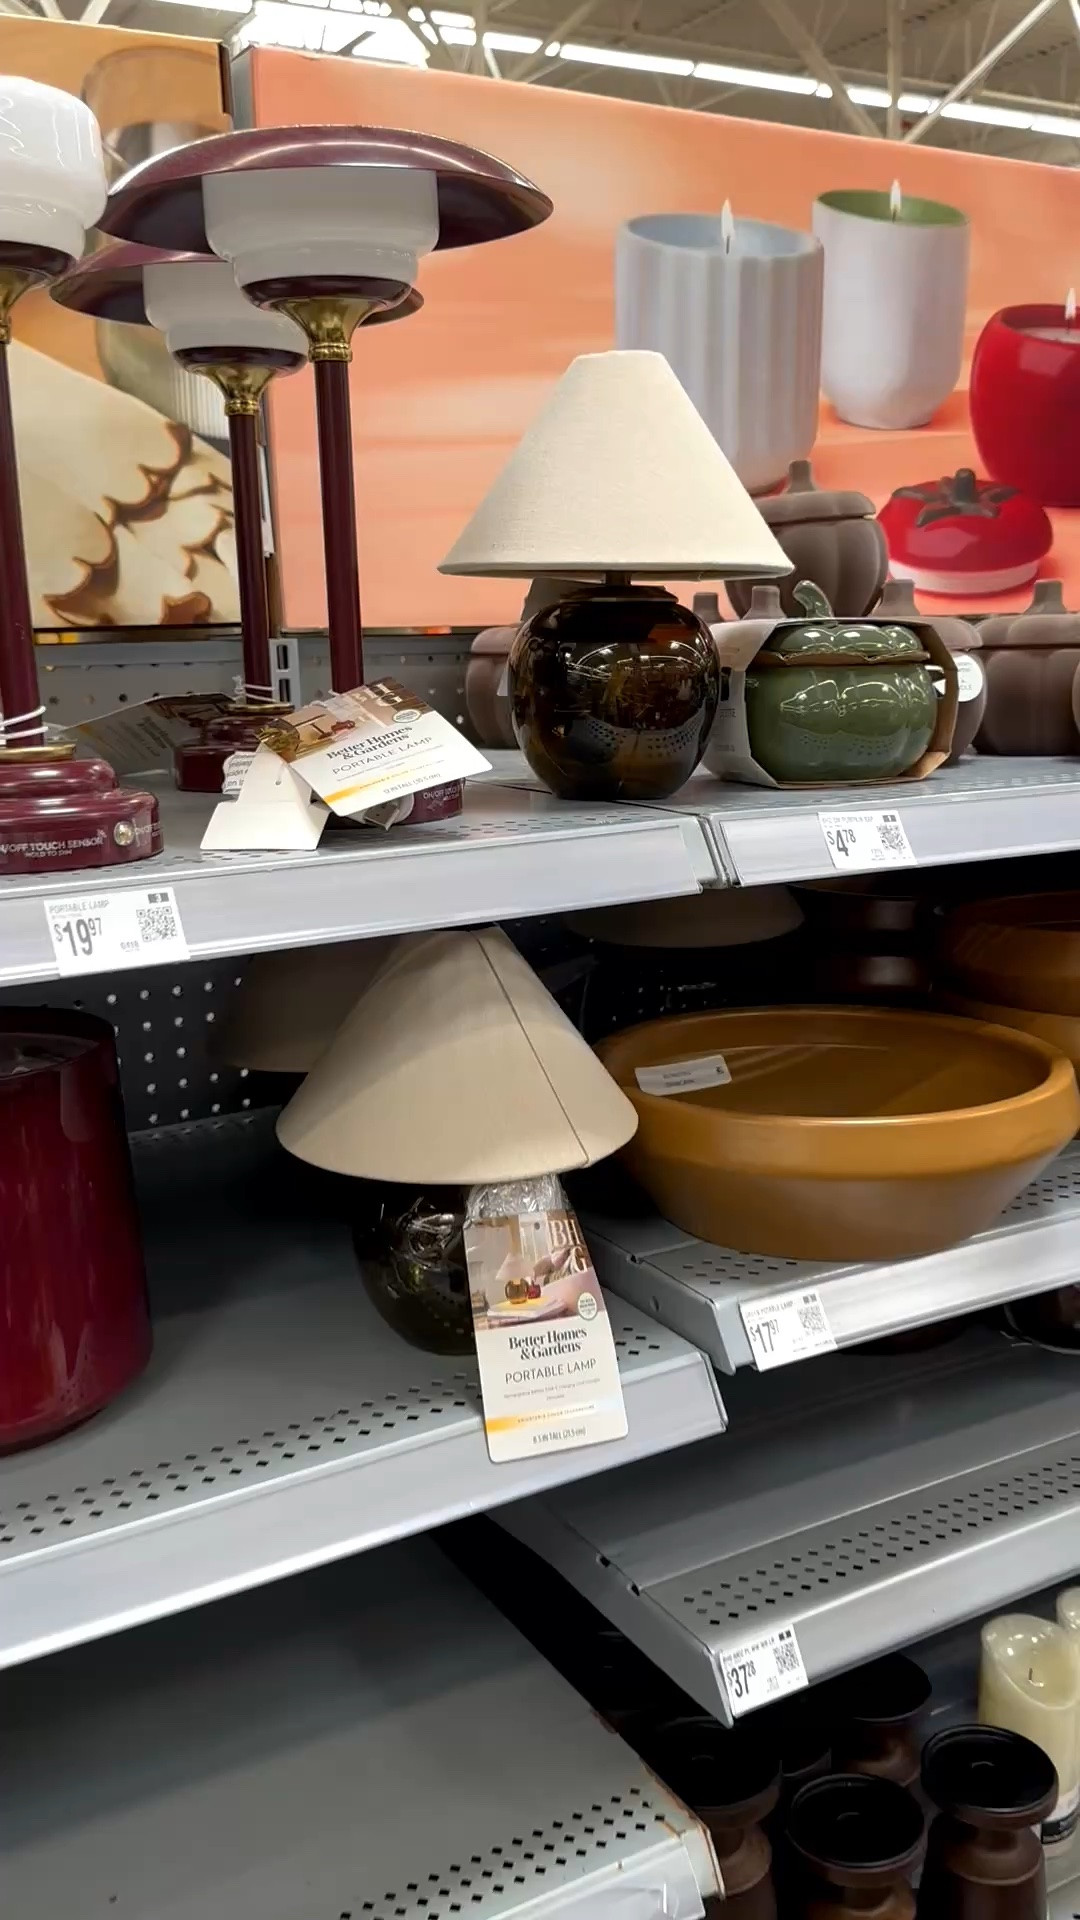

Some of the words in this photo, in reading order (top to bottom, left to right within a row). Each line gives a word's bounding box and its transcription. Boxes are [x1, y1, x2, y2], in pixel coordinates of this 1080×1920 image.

[326, 742, 369, 759] Better
[366, 726, 413, 747] Homes
[332, 750, 396, 775] PORTABLE
[400, 736, 433, 752] LAMP
[30, 840, 66, 852] TOUCH
[67, 836, 104, 849] SENSOR
[50, 901, 87, 914] PORTABLE
[88, 899, 110, 911] LAMP
[508, 1335, 546, 1350] Better
[547, 1327, 588, 1344] Homes
[505, 1364, 564, 1384] PORTABLE
[567, 1358, 597, 1374] LAMP
